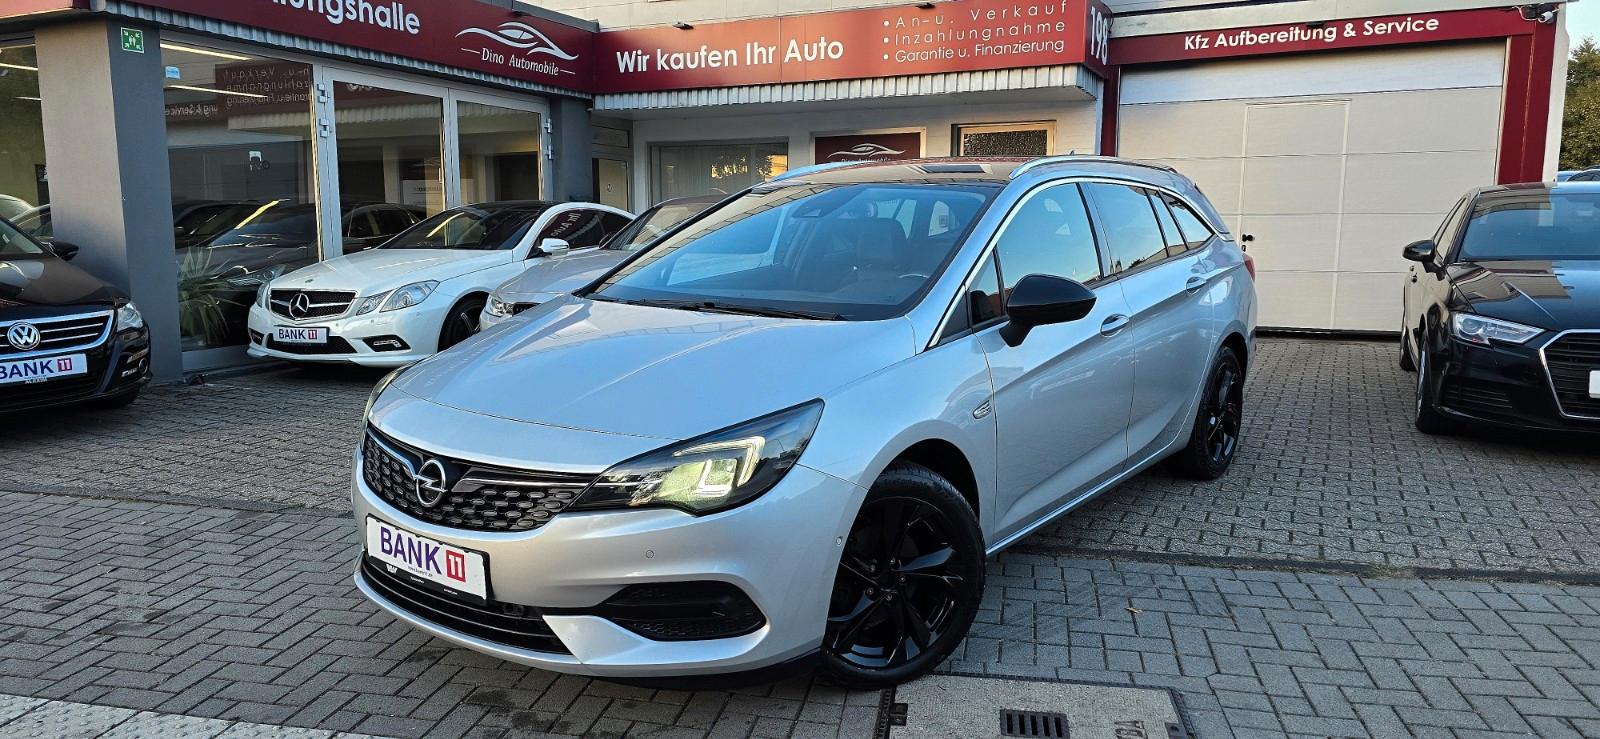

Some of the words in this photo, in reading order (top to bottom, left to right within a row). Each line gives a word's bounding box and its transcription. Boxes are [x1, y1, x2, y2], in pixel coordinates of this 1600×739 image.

[273, 0, 420, 34] ngshalle
[970, 1, 1066, 21] Verkauf
[896, 21, 1065, 45] Inzahlungnahme
[1090, 6, 1108, 65] 198
[1184, 35, 1209, 50] Kfz
[1214, 25, 1337, 49] Aufbereitung
[1343, 22, 1356, 37] &
[1363, 16, 1439, 36] Service
[482, 47, 505, 65] Dino
[508, 54, 559, 76] Automobile
[616, 49, 650, 73] Wir
[657, 45, 738, 71] kaufen
[746, 42, 776, 65] Ihr
[784, 36, 844, 62] Auto
[896, 47, 954, 63] Garantie
[958, 49, 970, 58] u.
[975, 39, 1064, 58] Finanzierung
[279, 329, 306, 340] BANK
[308, 330, 317, 339] 11
[0, 360, 54, 379] BANK
[58, 359, 72, 372] 11
[380, 526, 442, 575] BANK
[447, 553, 464, 580] 11
